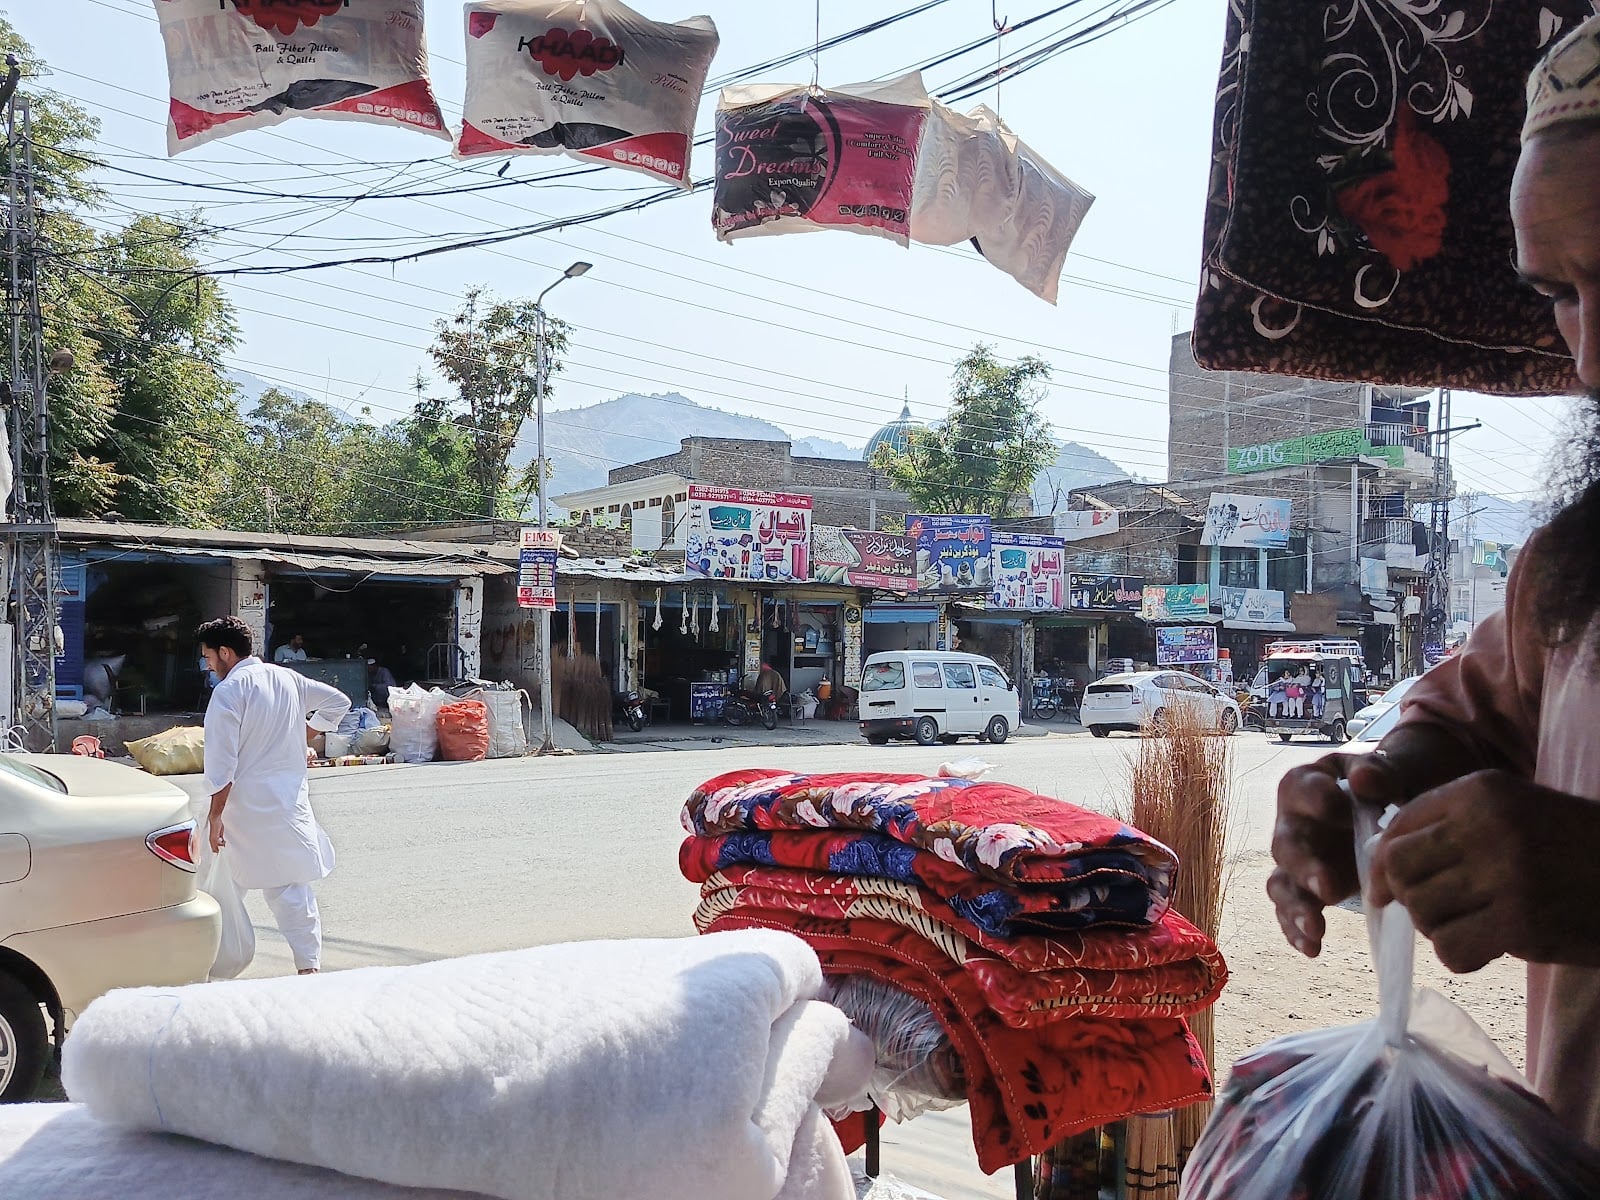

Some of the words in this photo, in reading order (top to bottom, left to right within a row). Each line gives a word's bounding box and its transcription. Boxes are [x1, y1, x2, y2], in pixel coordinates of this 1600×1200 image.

[252, 44, 274, 53] Ball
[276, 43, 305, 55] Fiber
[308, 42, 339, 54] Pillow
[286, 54, 316, 65] Quilts
[517, 36, 625, 66] KHAADI
[716, 115, 782, 150] Sweet
[724, 144, 822, 180] Dreams
[759, 510, 807, 546] اقبال
